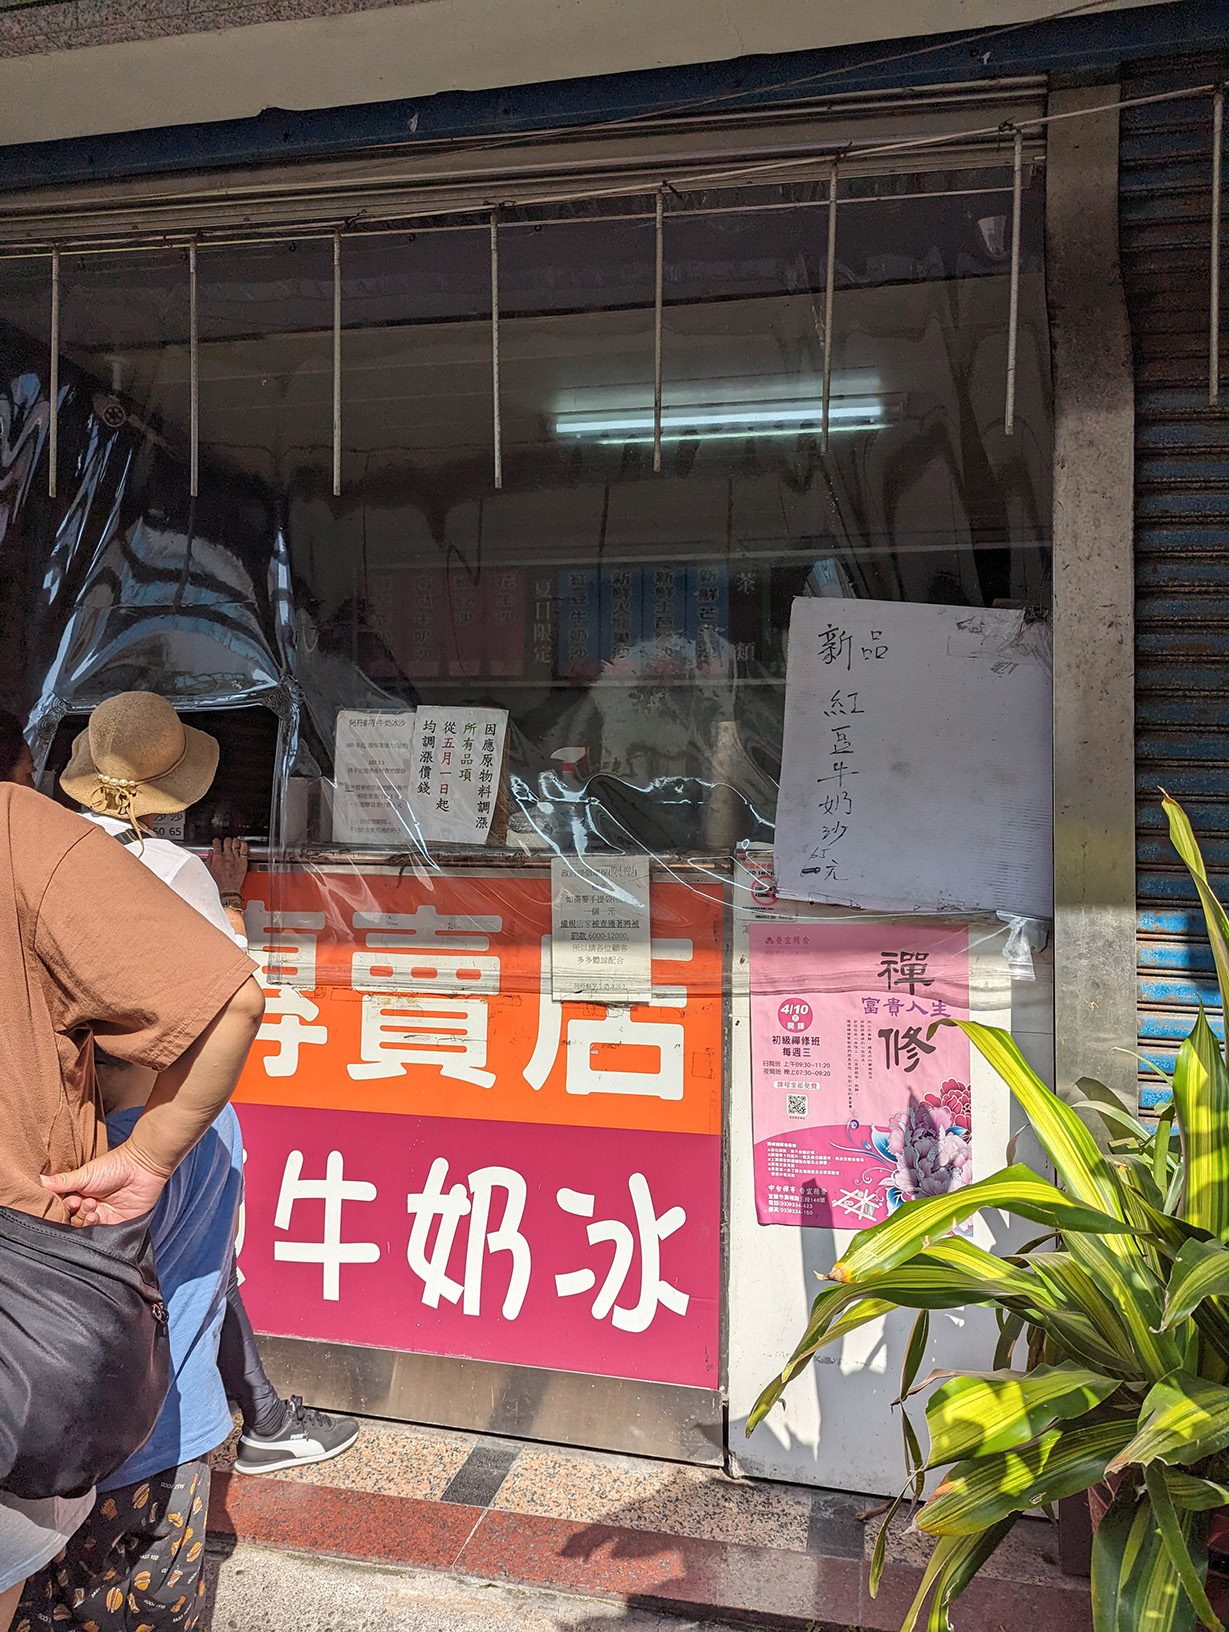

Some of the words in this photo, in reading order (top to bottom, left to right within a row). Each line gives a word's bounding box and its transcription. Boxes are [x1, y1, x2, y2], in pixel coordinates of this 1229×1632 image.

[533, 580, 554, 665] 夏日限定
[817, 624, 888, 671] 新品
[417, 720, 437, 795] 均調漲價錢
[436, 721, 457, 812] 從五月一日起
[459, 722, 477, 782] 所有品項
[816, 690, 865, 846] 紅豆牛奶沙
[475, 723, 497, 829] 因應原物料調漲
[169, 827, 182, 836] 65
[877, 951, 935, 996] 禪
[780, 1004, 809, 1015] 4/10
[861, 997, 952, 1018] 富貴人生
[772, 1035, 820, 1046] 初級禪修班
[783, 1047, 811, 1057] 每週三
[877, 1026, 937, 1073] 修
[238, 1149, 690, 1333] 牛奶冰
